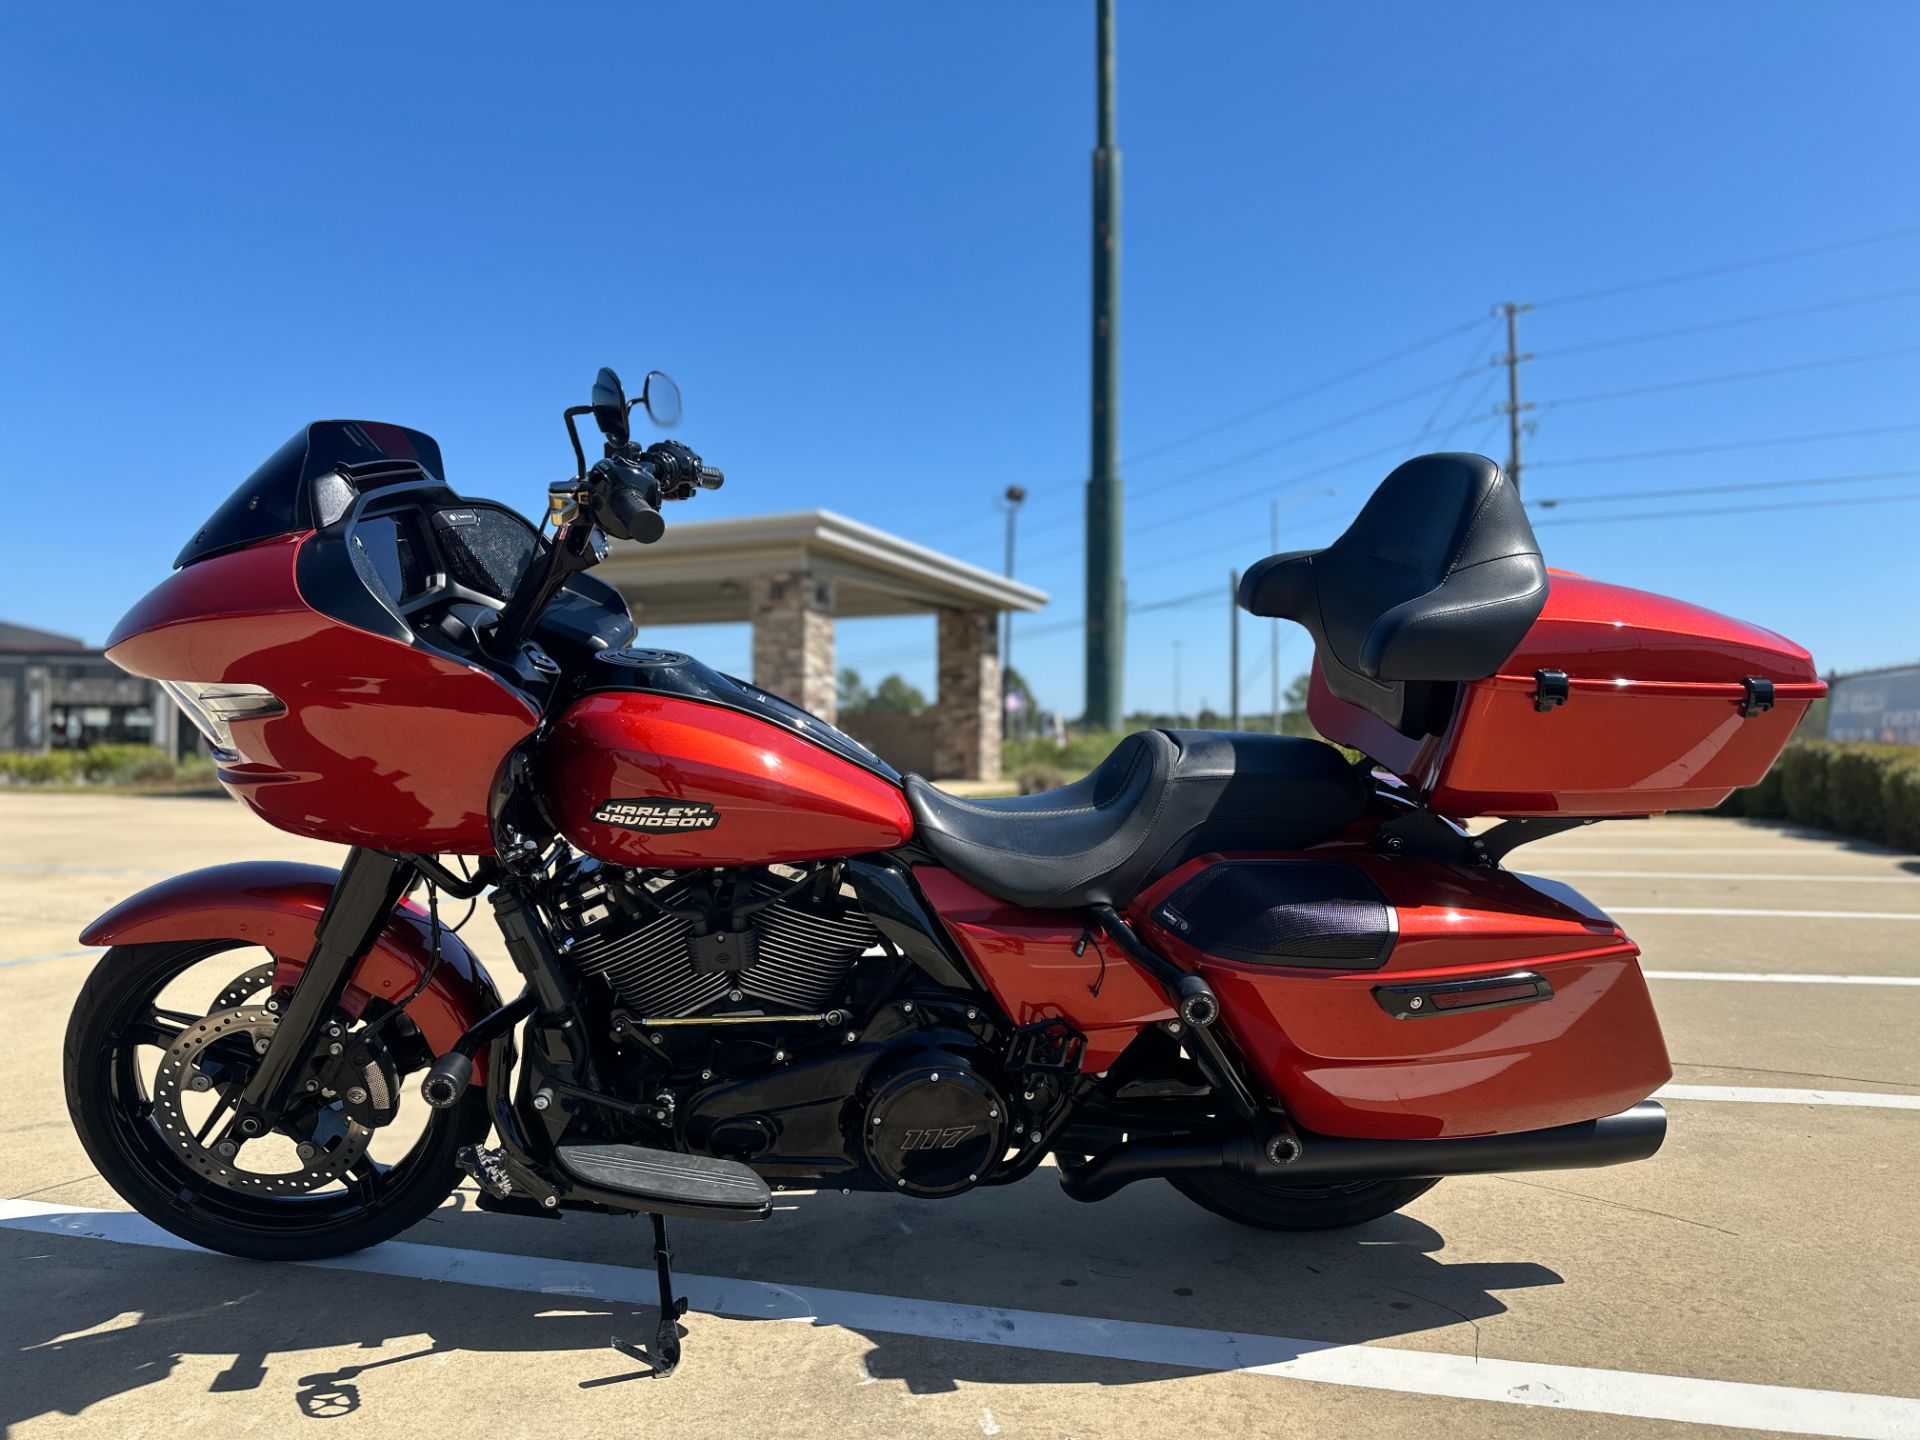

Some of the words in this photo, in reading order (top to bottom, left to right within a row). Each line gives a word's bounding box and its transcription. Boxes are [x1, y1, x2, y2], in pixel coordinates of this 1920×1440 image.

[605, 804, 707, 817] HARLEY-
[595, 812, 714, 827] DAVIDSON
[901, 1125, 976, 1150] 117
